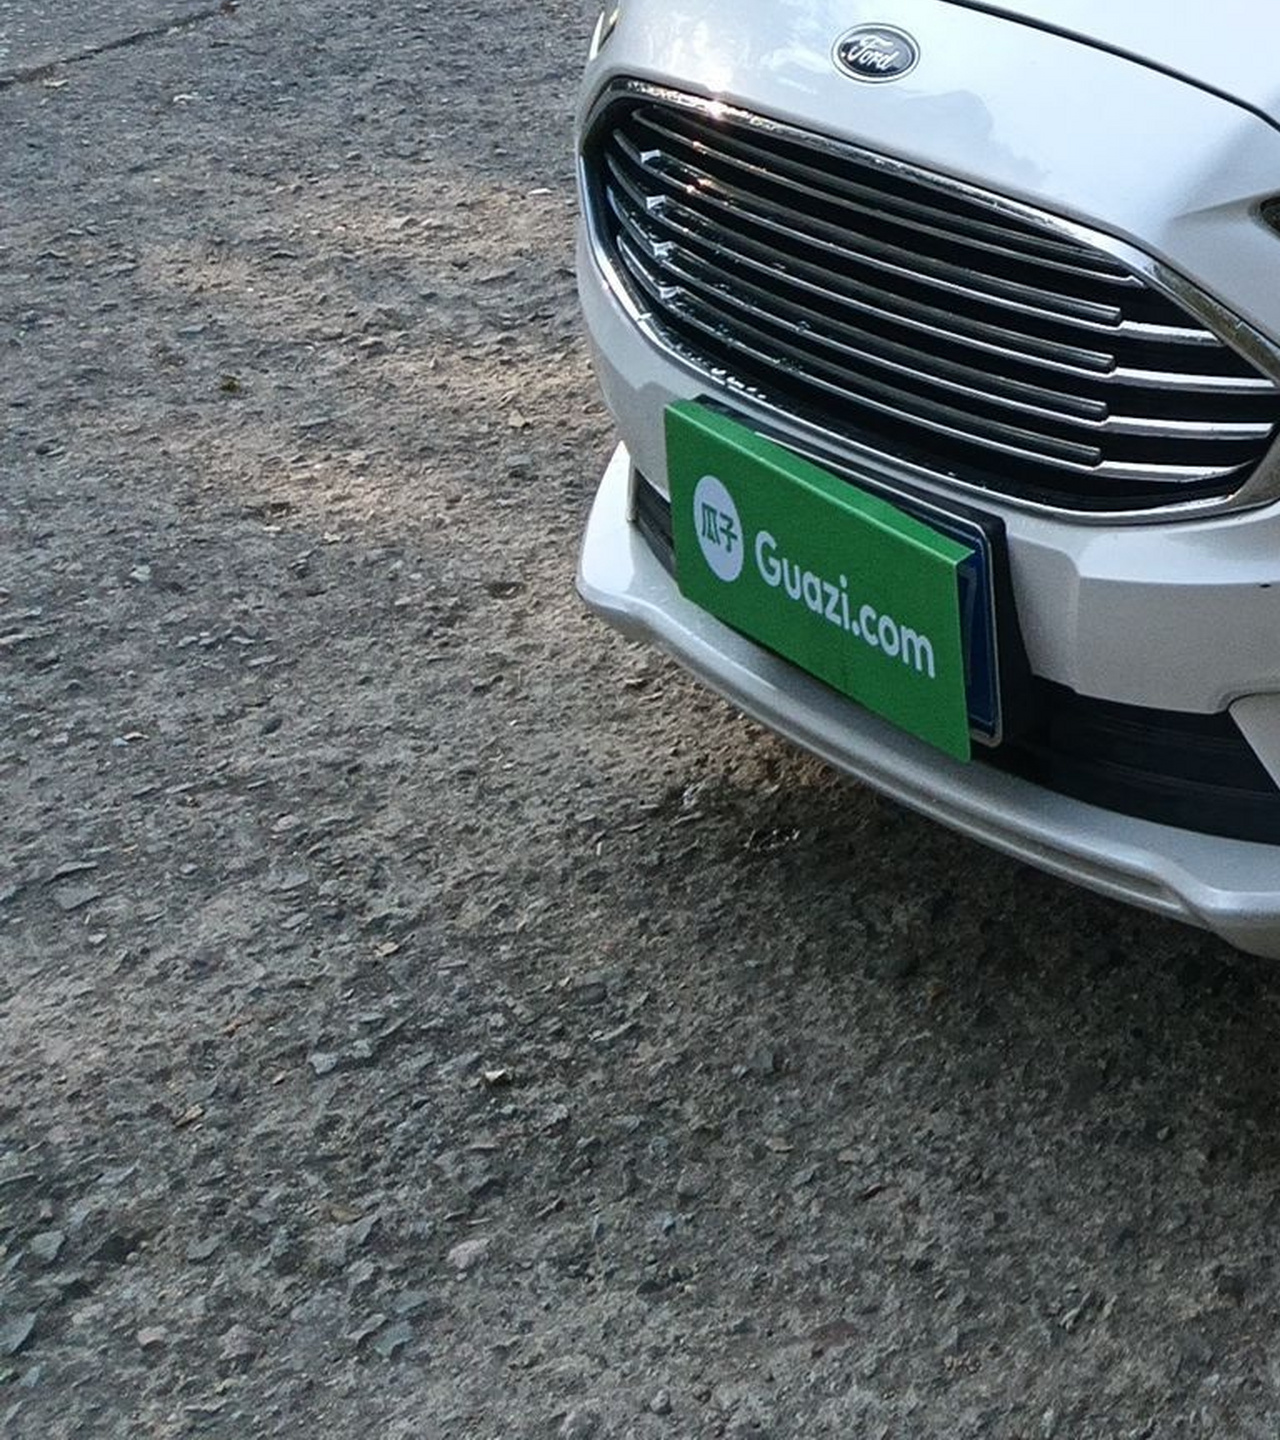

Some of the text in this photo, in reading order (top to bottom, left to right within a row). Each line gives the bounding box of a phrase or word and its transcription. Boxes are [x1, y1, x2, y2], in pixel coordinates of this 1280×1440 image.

[841, 34, 900, 71] Ford
[701, 502, 738, 554] 瓜子
[755, 530, 936, 679] Guazi.com
